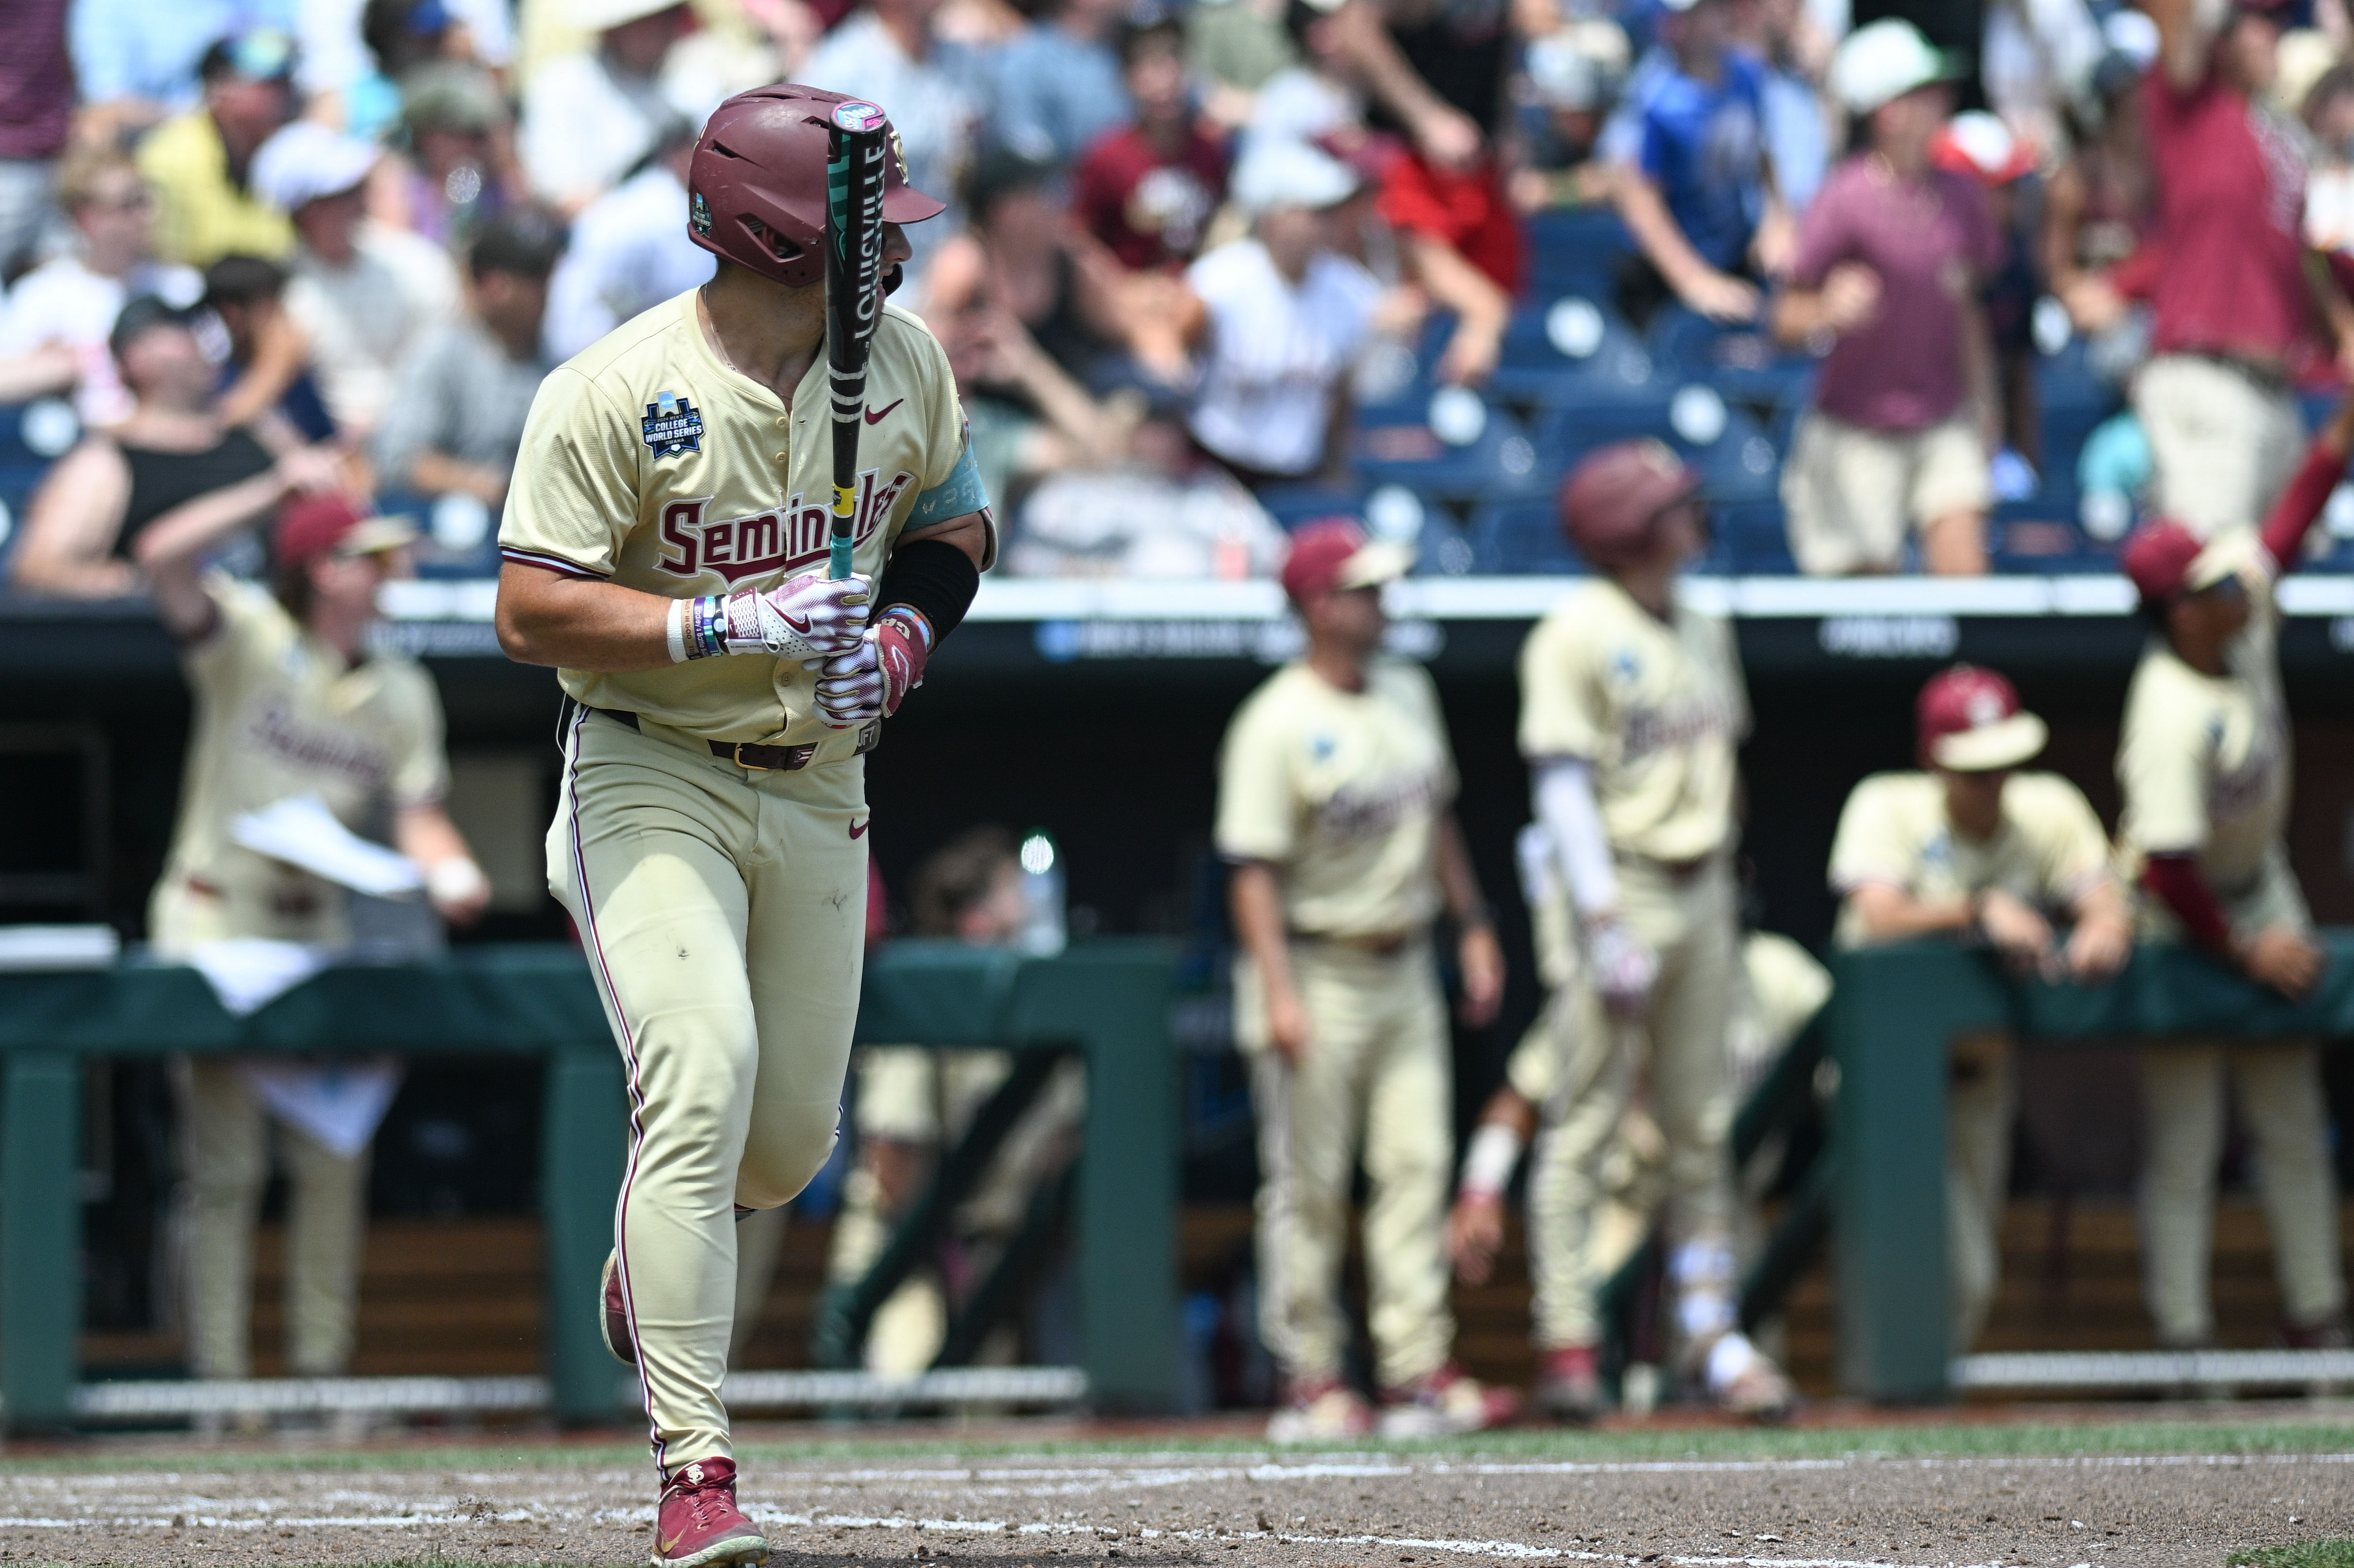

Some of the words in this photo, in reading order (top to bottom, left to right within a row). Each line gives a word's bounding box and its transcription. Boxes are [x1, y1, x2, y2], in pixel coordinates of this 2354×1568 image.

[855, 136, 886, 339] LOUISVILLE
[645, 430, 672, 443] WORLD
[674, 425, 702, 439] SERIES
[655, 418, 688, 432] COLLEGE
[652, 467, 916, 579] Seminles
[858, 726, 877, 747] JF7
